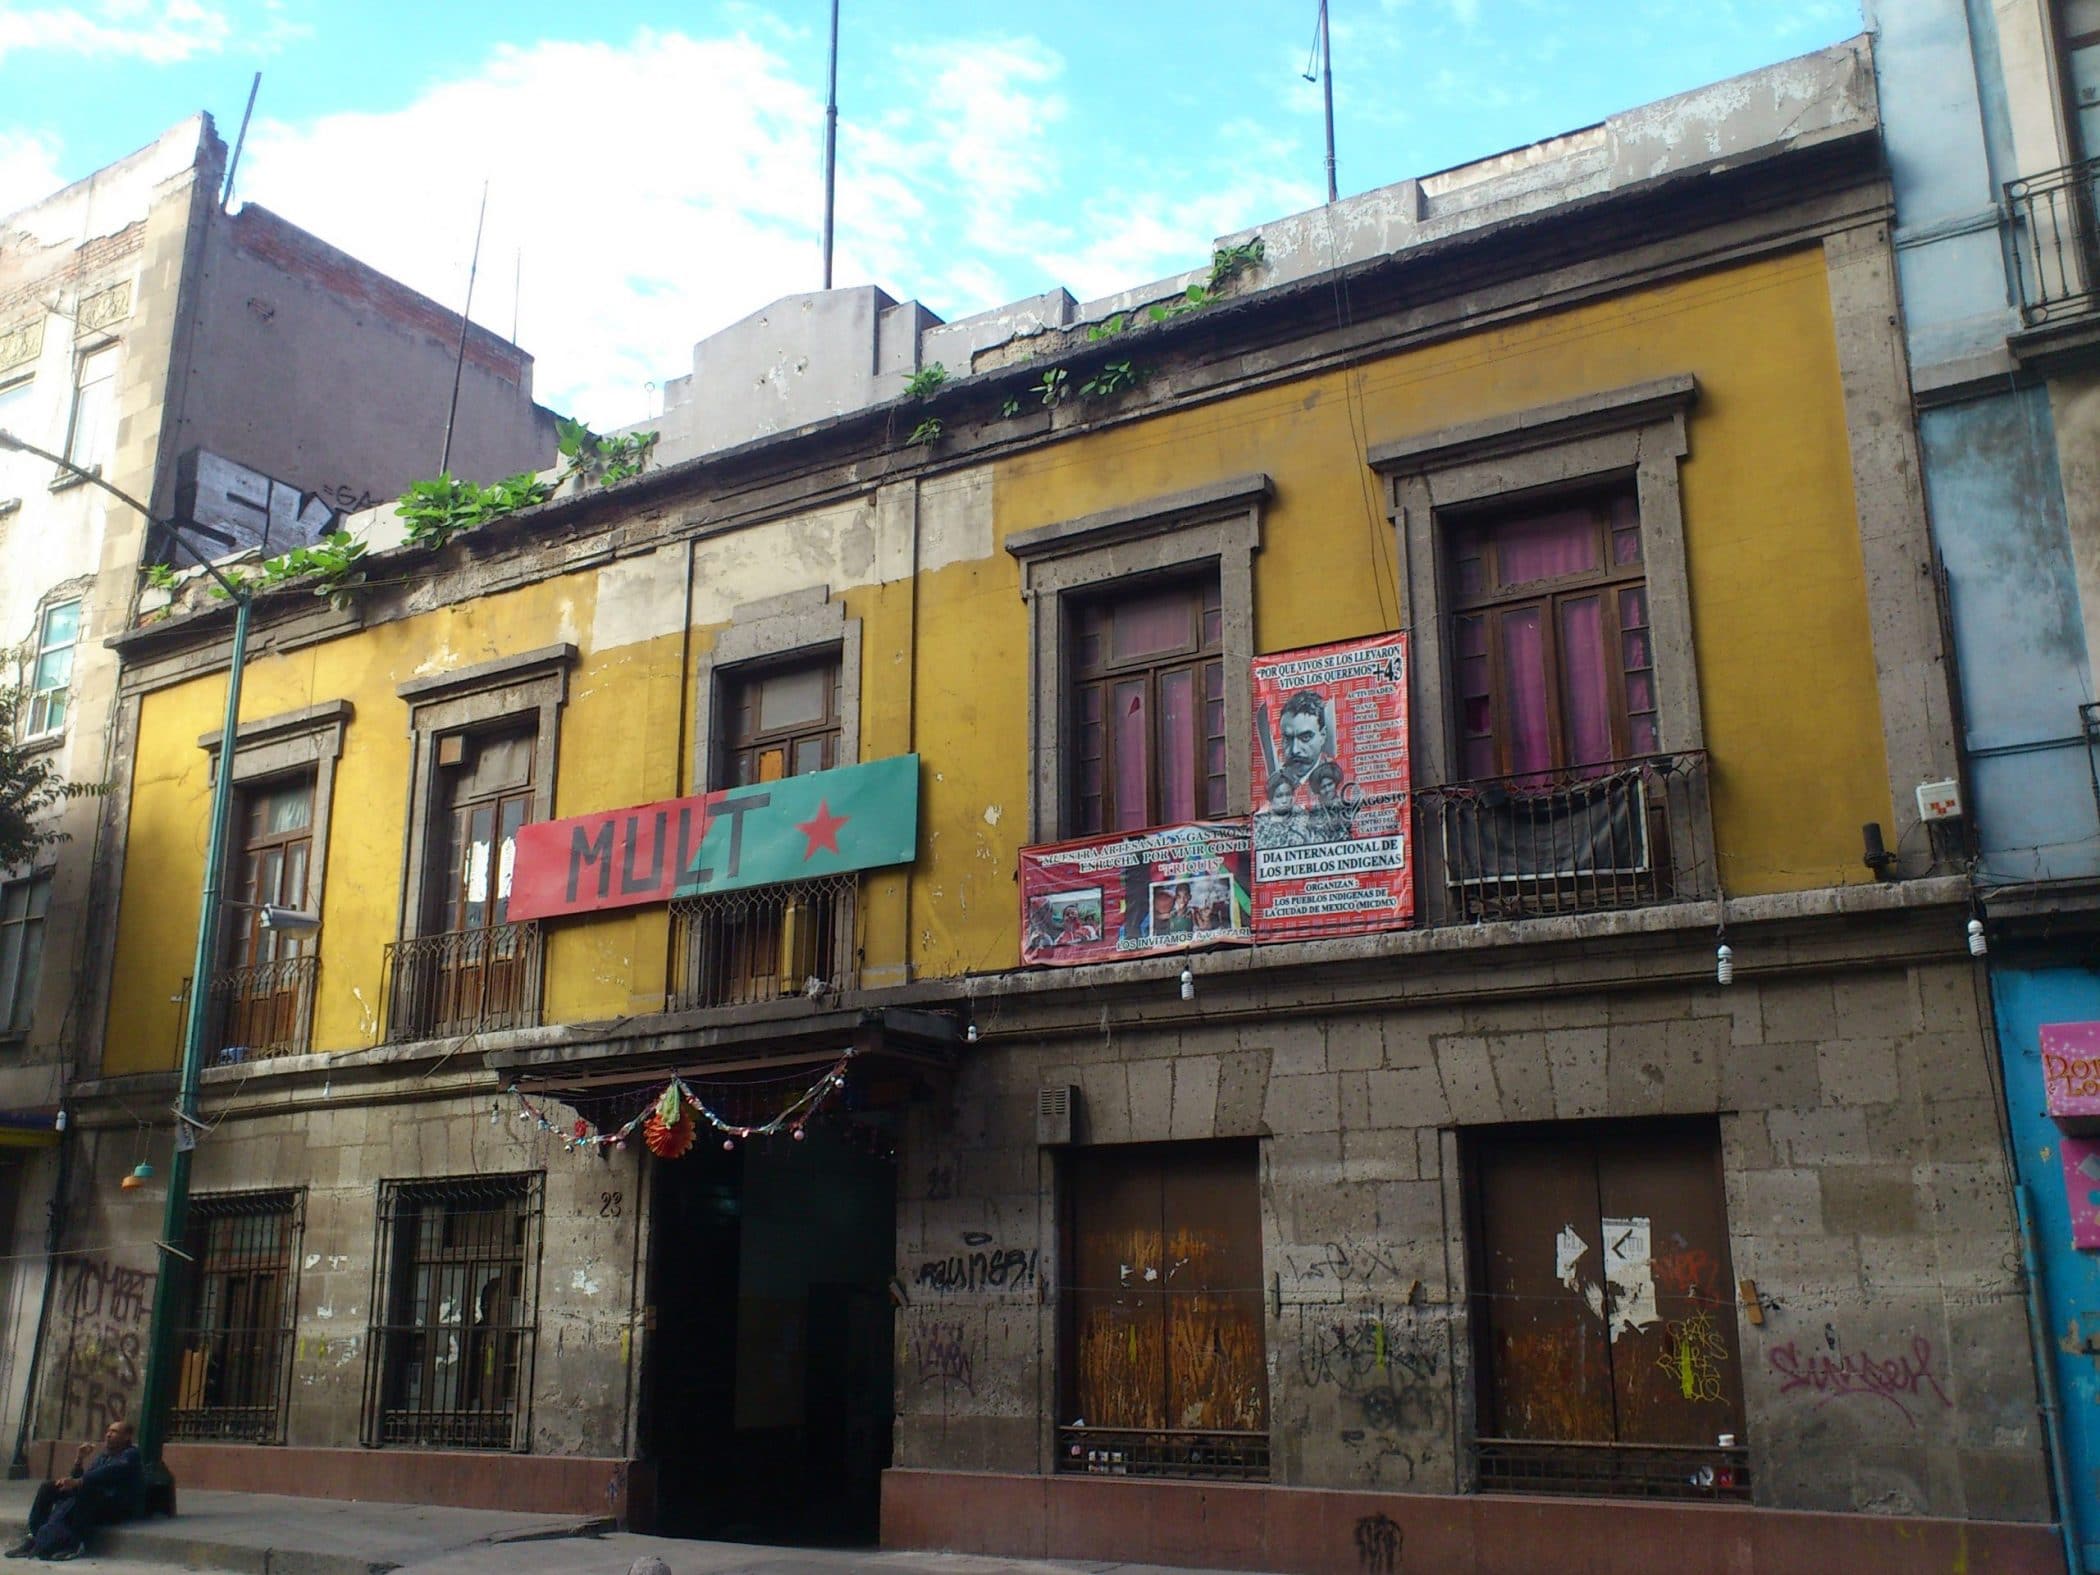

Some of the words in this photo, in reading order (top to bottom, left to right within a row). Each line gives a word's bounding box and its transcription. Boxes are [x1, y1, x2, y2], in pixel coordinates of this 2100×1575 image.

[1279, 663, 1298, 675] QUE
[1298, 658, 1323, 672] VIVOS
[1324, 657, 1334, 667] SE
[1337, 654, 1353, 665] LOS
[1355, 646, 1400, 662] LLEVARON
[1373, 658, 1402, 681] +43
[1280, 676, 1305, 688] VIVOS
[1307, 672, 1322, 684] LOS
[1360, 792, 1406, 807] AGOSTO
[566, 792, 771, 903] MULT
[1100, 855, 1138, 869] LUCHA
[1144, 852, 1168, 863] POR
[1172, 845, 1204, 858] VIVIR
[1208, 841, 1235, 852] CON
[1101, 838, 1169, 856] ARTESANAL
[1263, 852, 1283, 864] DIA
[1285, 842, 1379, 860] INTERNACIONAL
[1382, 840, 1398, 850] DE
[1260, 867, 1281, 878] LOS
[1285, 860, 1336, 876] PUEBLOS
[1338, 854, 1401, 870] INDIGENAS
[1265, 908, 1275, 917] LA
[1276, 905, 1308, 916] CIUDAD
[1310, 904, 1320, 912] DE
[1322, 901, 1355, 912] MEXICO
[1274, 896, 1290, 906] LOS
[1292, 892, 1327, 904] PUEBLOS
[1329, 890, 1374, 901] INDIGENAS
[1118, 940, 1136, 950] LOS
[1138, 933, 1193, 948] INVITAMOS
[600, 1191, 622, 1217] 23
